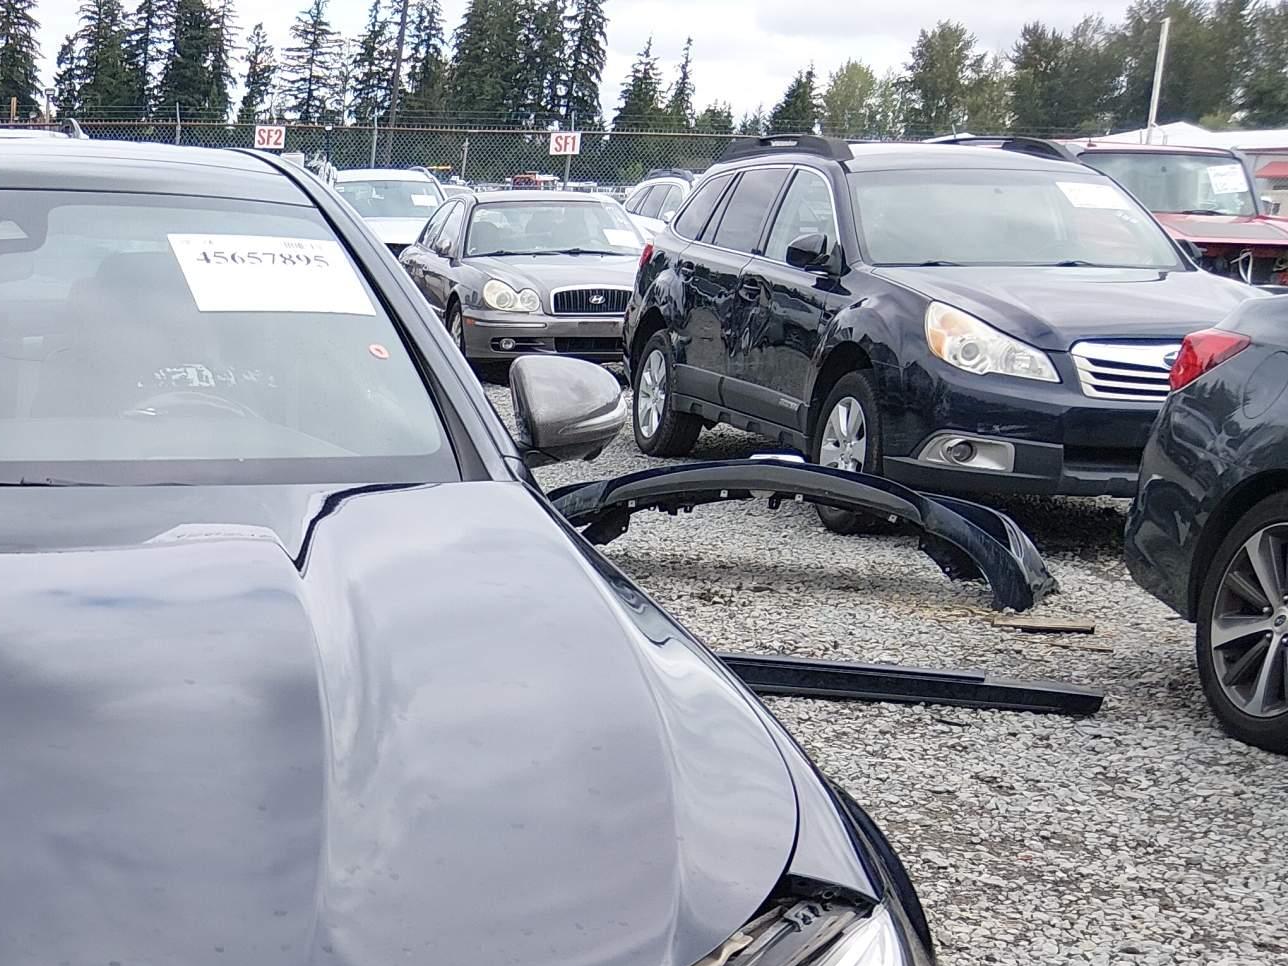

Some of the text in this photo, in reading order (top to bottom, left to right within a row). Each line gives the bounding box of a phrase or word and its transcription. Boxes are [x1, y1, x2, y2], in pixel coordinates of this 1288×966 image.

[257, 128, 283, 146] SF2
[555, 135, 577, 153] SF1
[196, 251, 330, 268] 45657895
